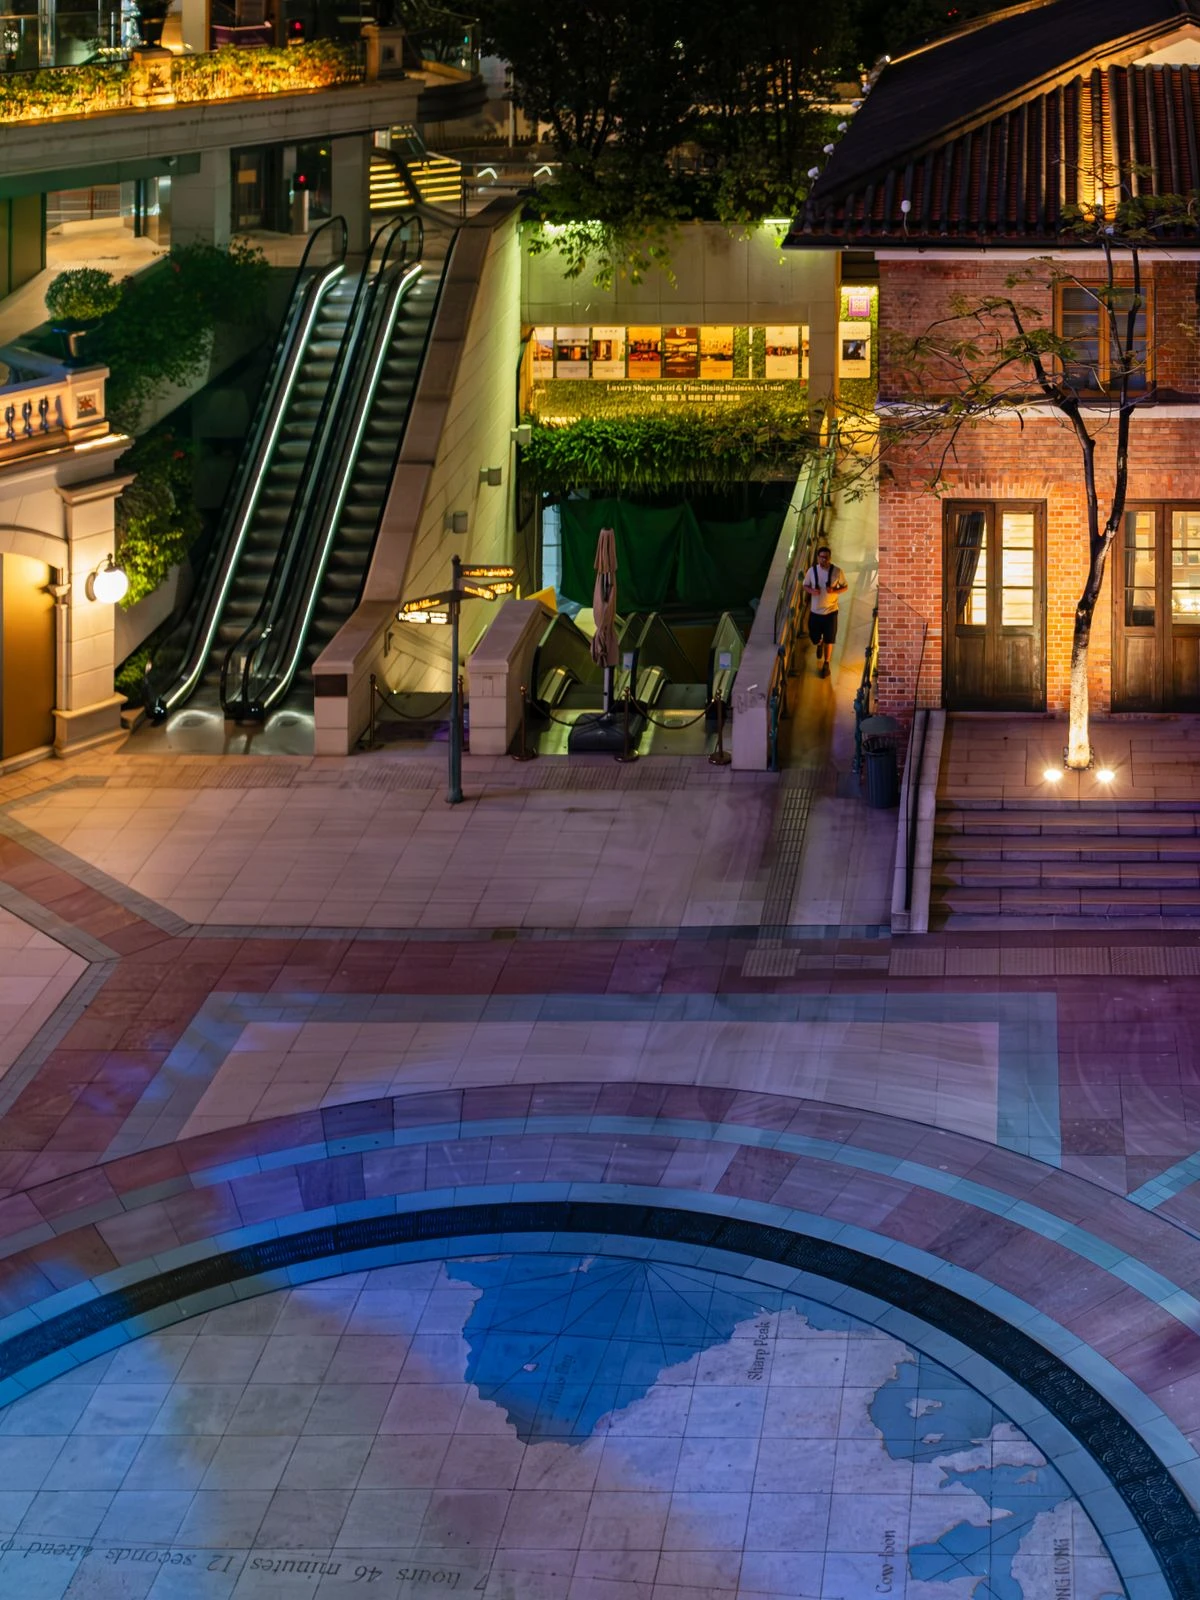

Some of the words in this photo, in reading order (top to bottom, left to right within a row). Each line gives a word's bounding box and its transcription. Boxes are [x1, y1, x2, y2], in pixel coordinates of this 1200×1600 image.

[753, 1321, 770, 1346] Peak
[747, 1349, 770, 1380] Sharp
[105, 1548, 195, 1565] seconds
[207, 1555, 233, 1573] 12
[876, 1530, 896, 1593] Cow-loon
[1053, 1538, 1071, 1574] KONG
[250, 1557, 342, 1580] minutes
[354, 1565, 382, 1582] 46
[396, 1567, 461, 1590] hours
